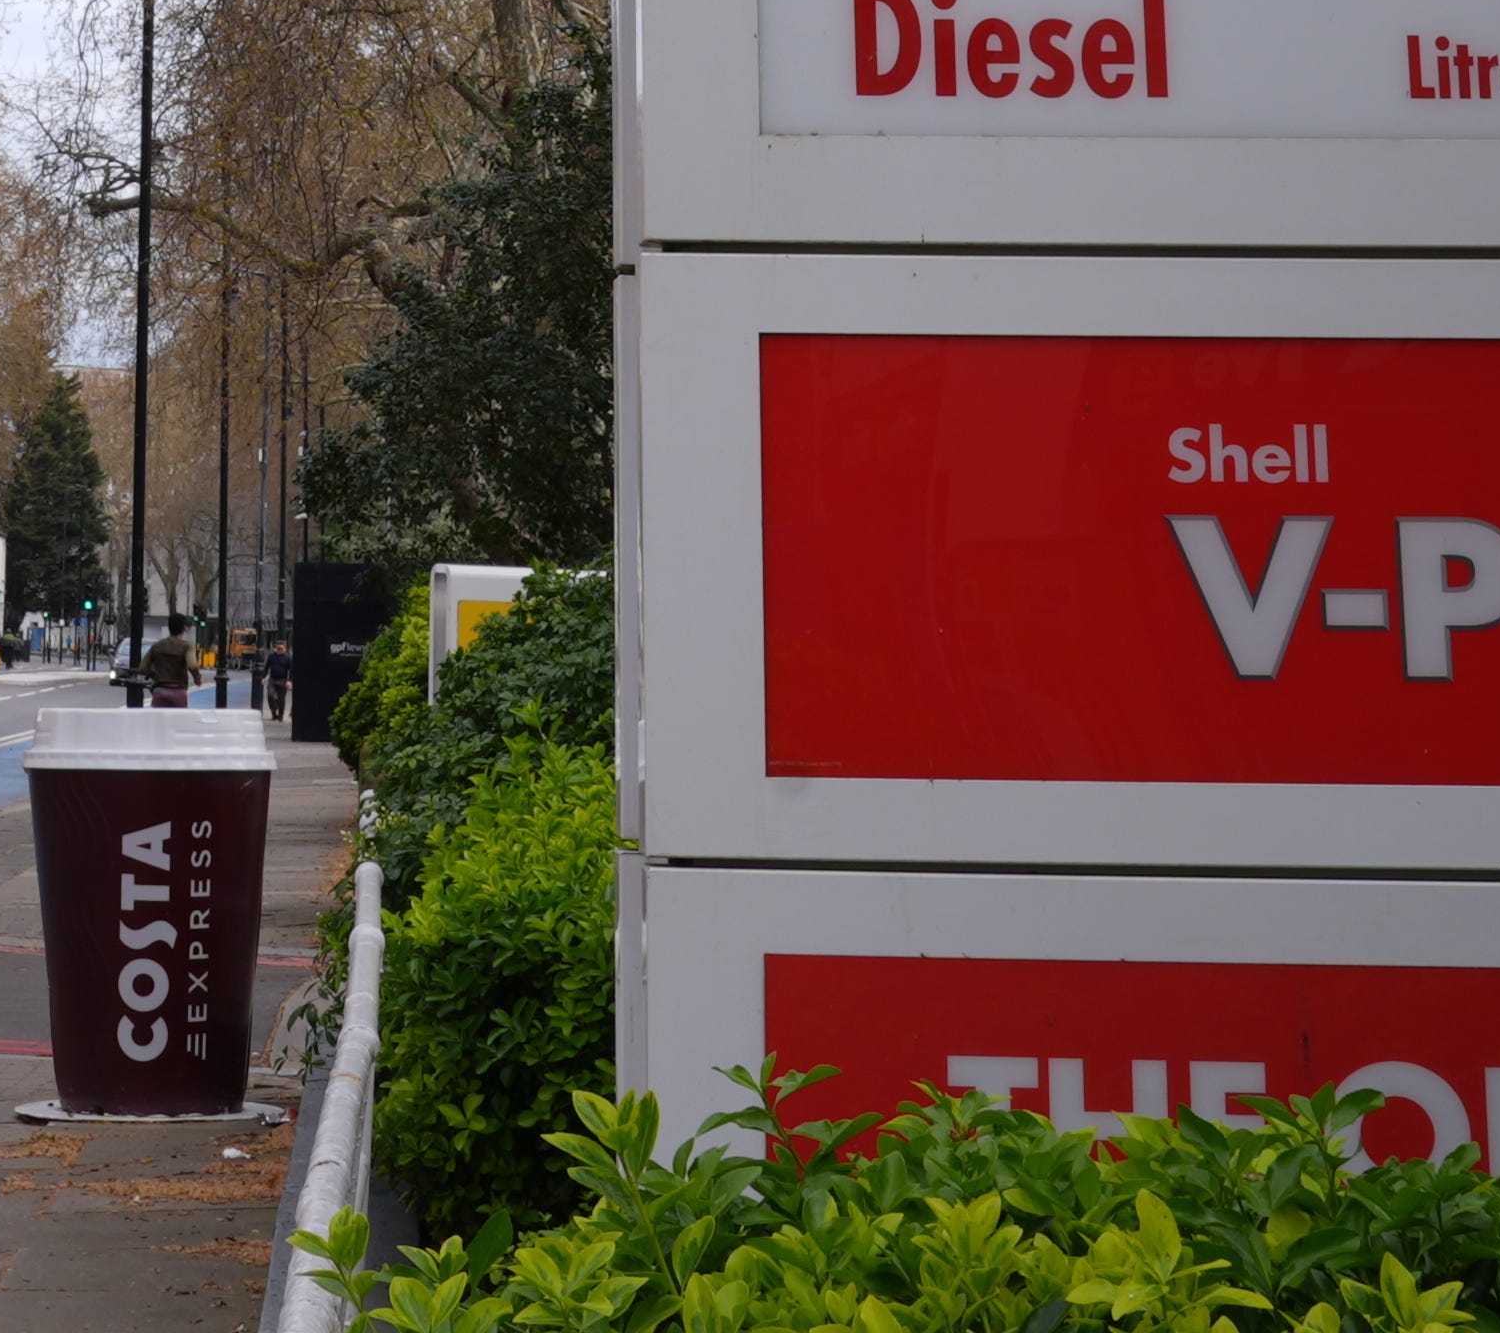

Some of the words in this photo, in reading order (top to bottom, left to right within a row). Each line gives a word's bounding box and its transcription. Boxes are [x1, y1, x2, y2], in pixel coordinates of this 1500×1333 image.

[1167, 423, 1330, 484] Shell
[117, 821, 178, 1063] COSTA
[187, 820, 213, 1023] EXPRESS
